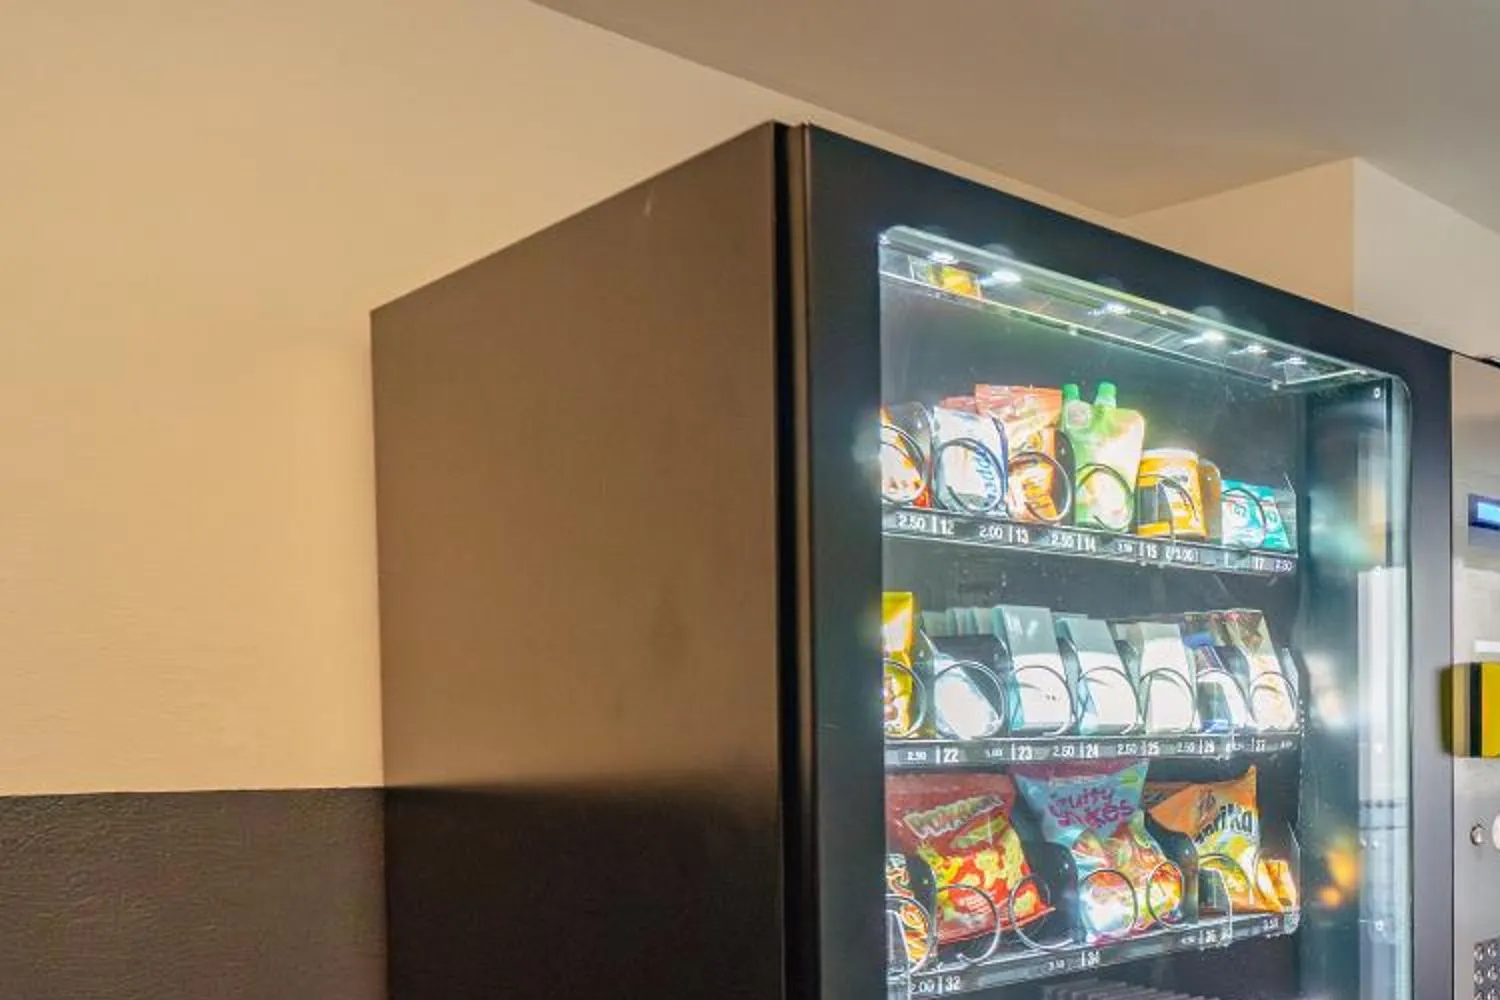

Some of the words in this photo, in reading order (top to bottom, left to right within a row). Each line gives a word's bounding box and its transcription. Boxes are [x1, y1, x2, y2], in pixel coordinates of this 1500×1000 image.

[943, 748, 959, 763] 22
[1018, 745, 1033, 761] 23
[945, 976, 961, 991] 32
